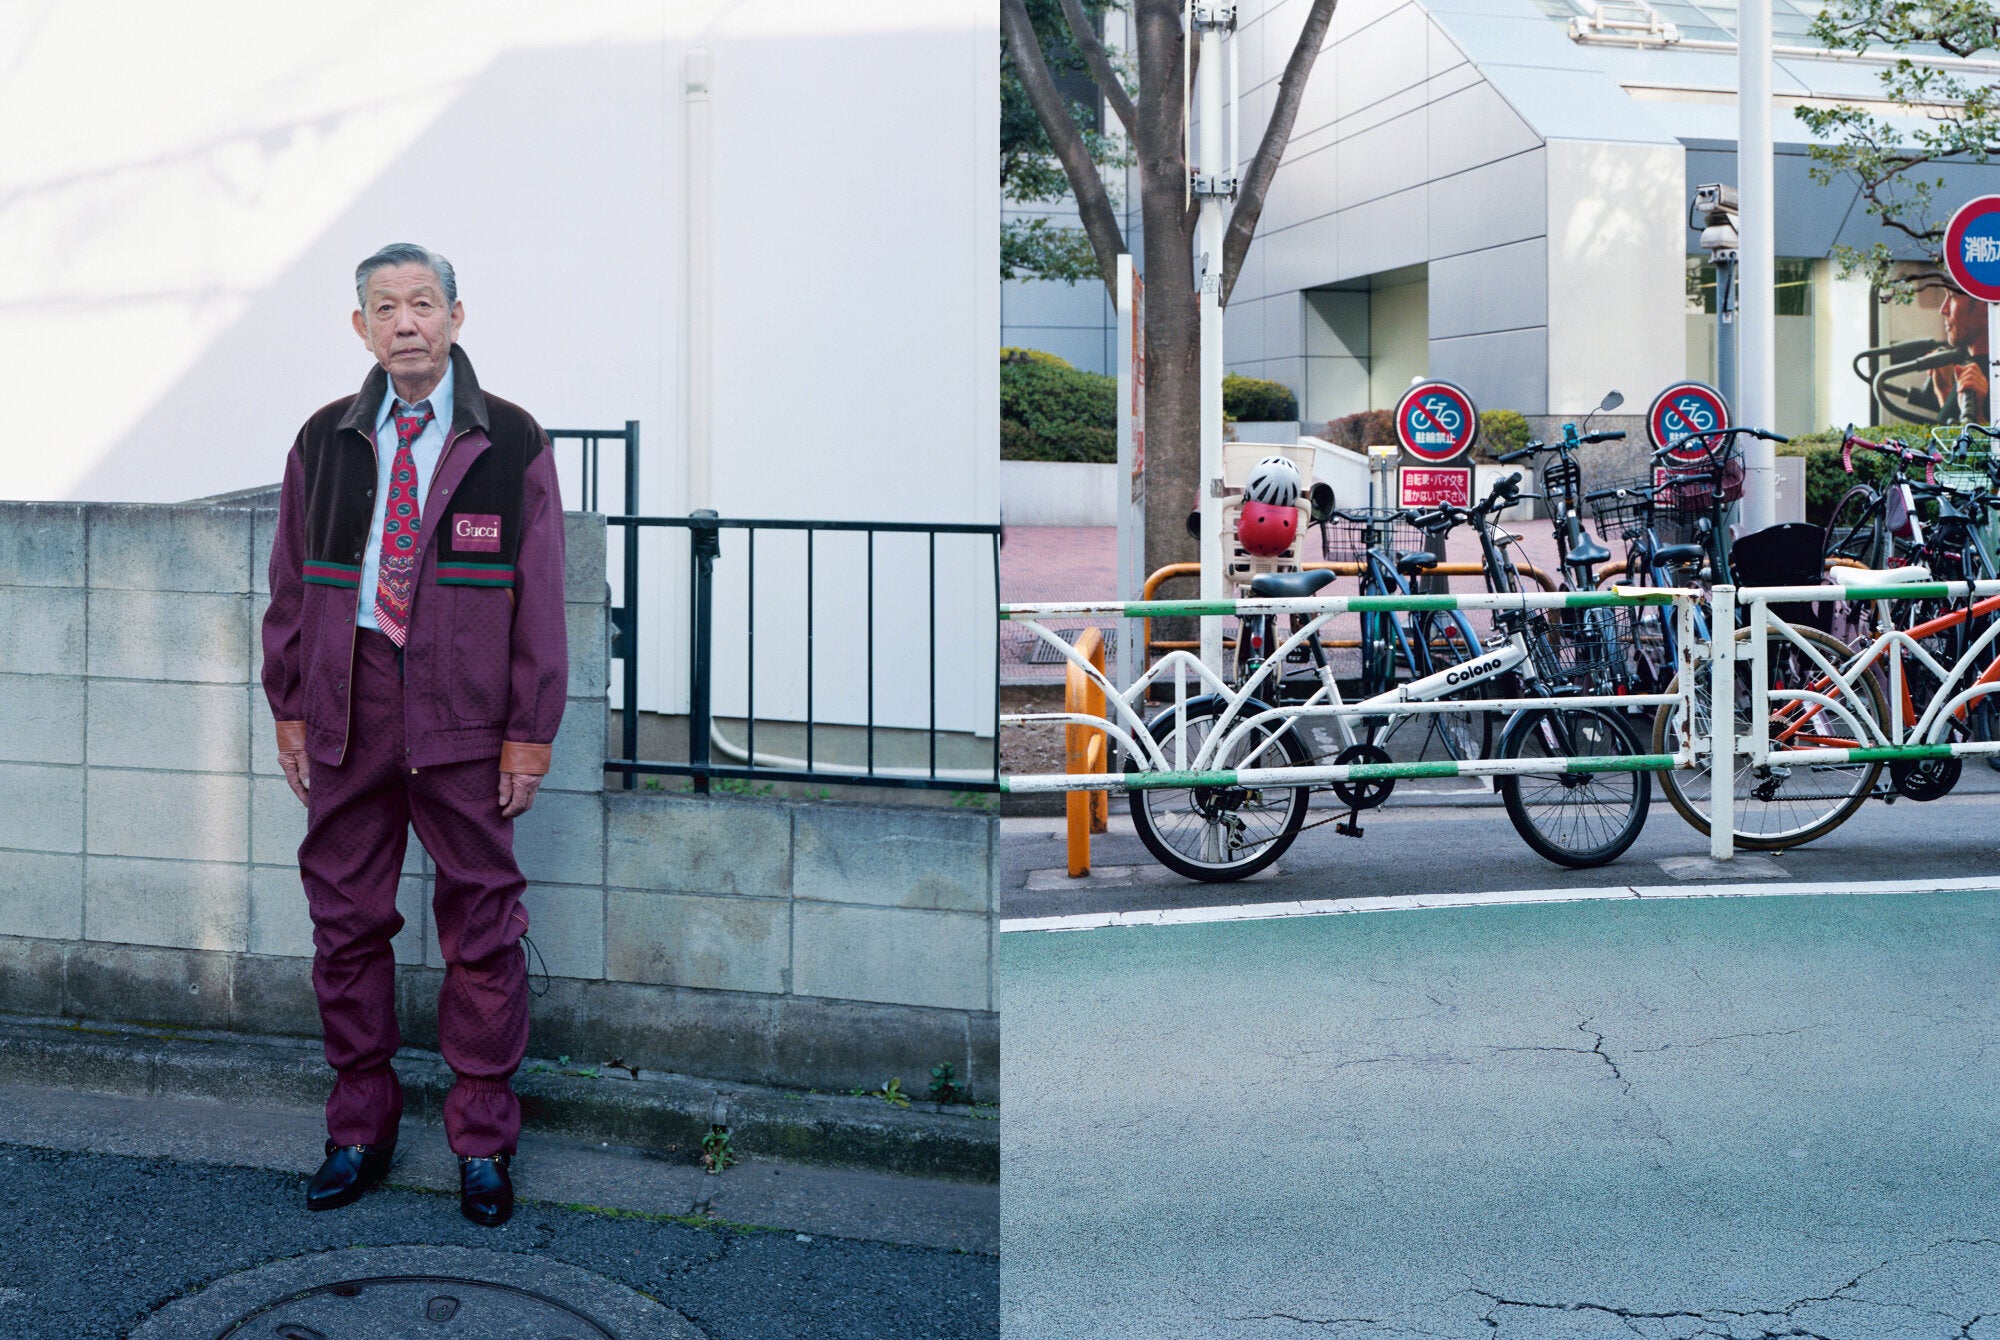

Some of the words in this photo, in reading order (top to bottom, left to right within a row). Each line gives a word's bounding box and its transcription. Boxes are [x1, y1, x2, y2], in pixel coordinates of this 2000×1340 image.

[1415, 431, 1457, 444] 駐輪禁止
[1404, 489, 1467, 502] 置かないで下さい
[456, 520, 498, 538] Gucci
[1446, 658, 1502, 685] Colono
